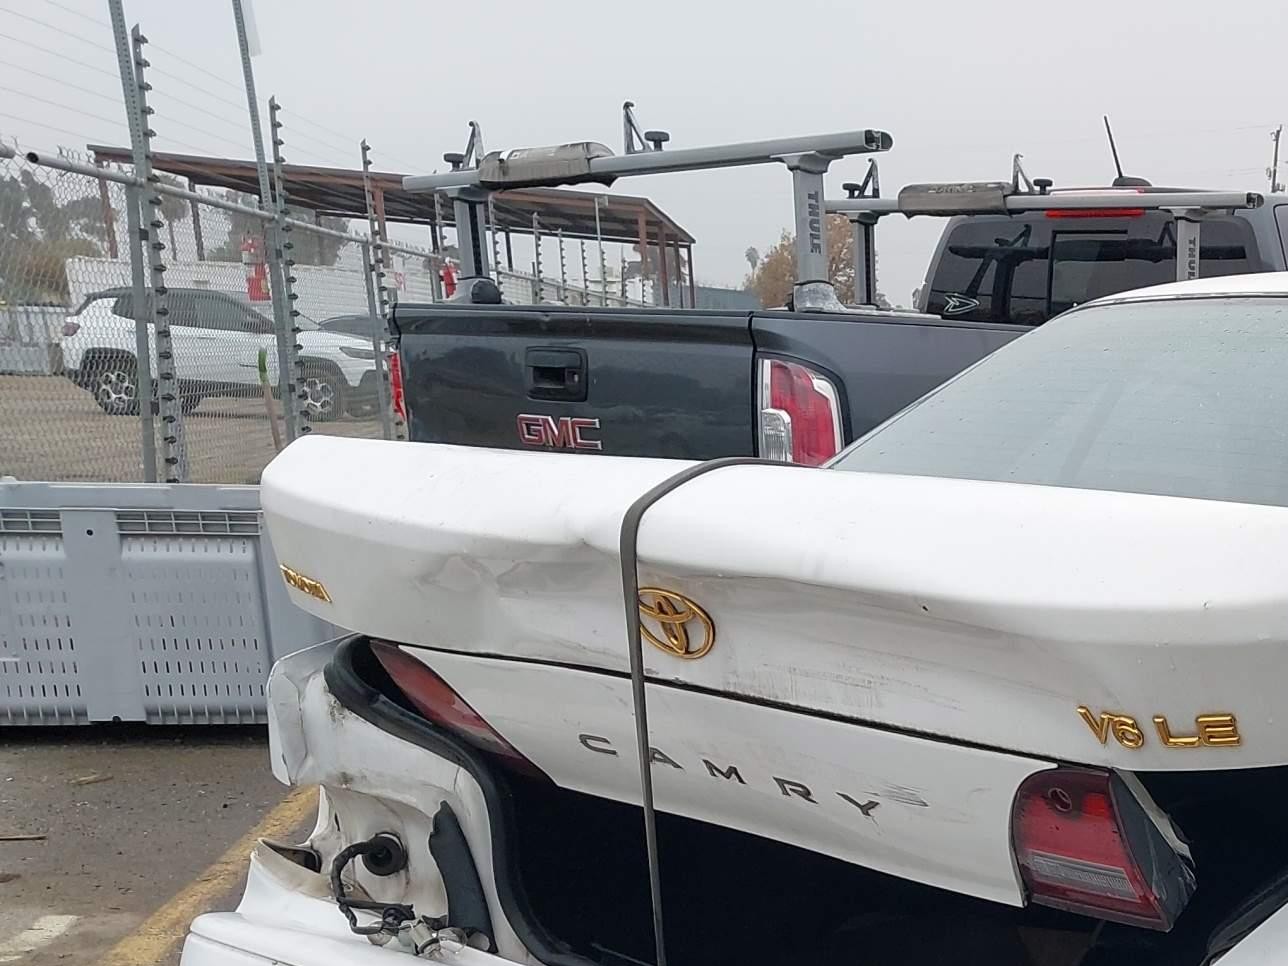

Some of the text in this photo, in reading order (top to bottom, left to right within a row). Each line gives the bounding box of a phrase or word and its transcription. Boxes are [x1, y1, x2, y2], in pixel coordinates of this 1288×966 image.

[808, 191, 822, 255] THULE
[517, 413, 602, 450] GMC
[1076, 705, 1241, 750] V6 LE
[578, 732, 882, 818] CAMRY
